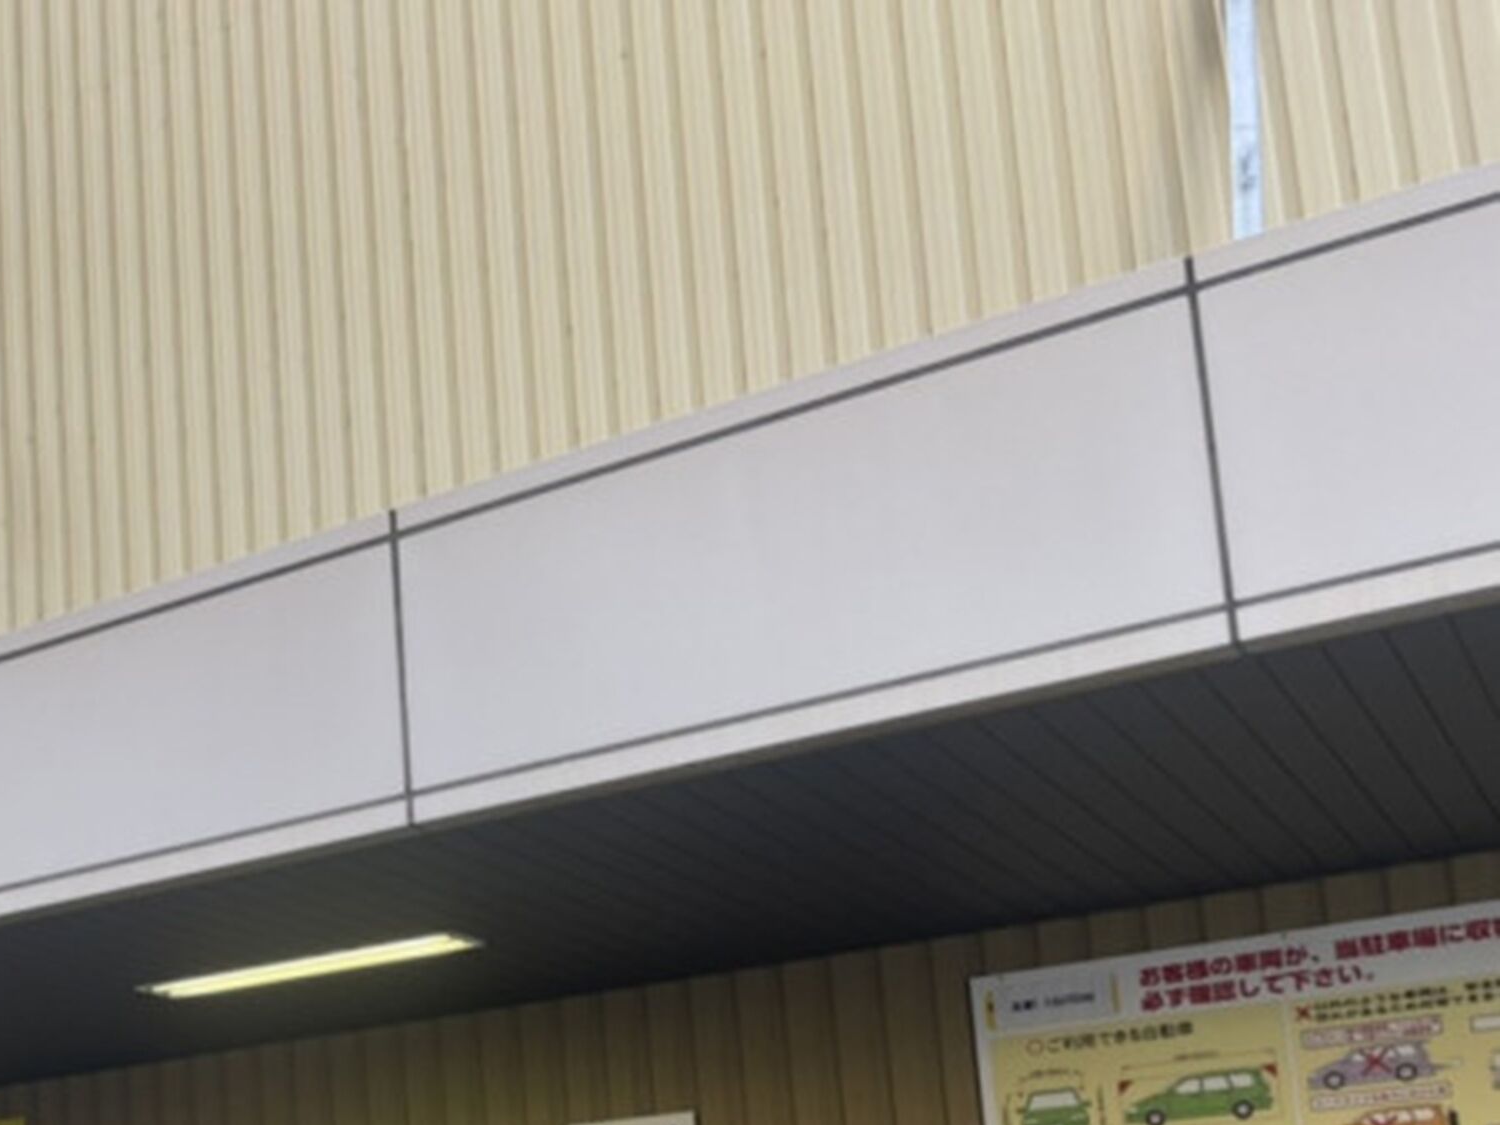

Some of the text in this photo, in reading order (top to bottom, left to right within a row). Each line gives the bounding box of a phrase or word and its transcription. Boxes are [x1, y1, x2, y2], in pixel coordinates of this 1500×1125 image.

[1139, 917, 1500, 987] お客様の車両が、当駐車場に収
